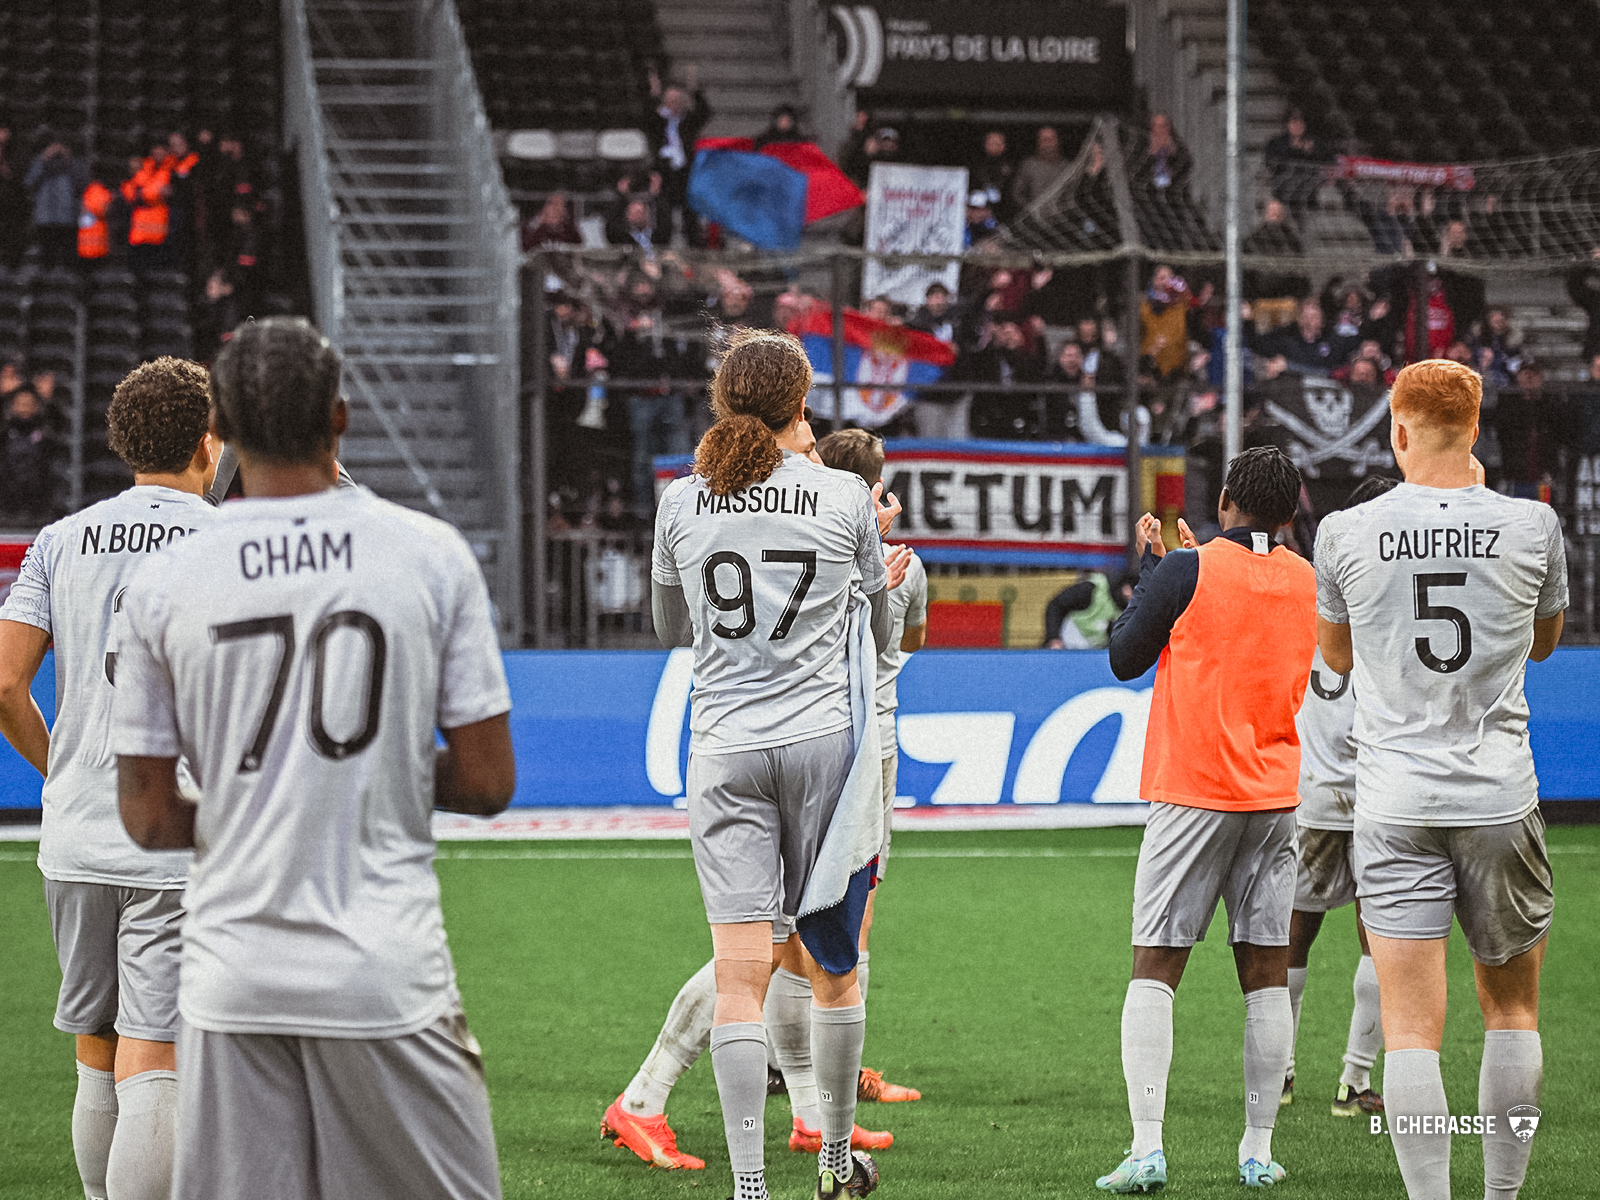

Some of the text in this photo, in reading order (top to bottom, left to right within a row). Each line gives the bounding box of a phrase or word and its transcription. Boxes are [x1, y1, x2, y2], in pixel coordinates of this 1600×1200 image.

[886, 34, 1101, 63] PAYS DE LA LOIRE
[240, 532, 352, 580] CHAM
[701, 549, 817, 641] 97
[1413, 572, 1472, 674] 5
[207, 610, 387, 774] 70
[743, 1119, 755, 1128] 97
